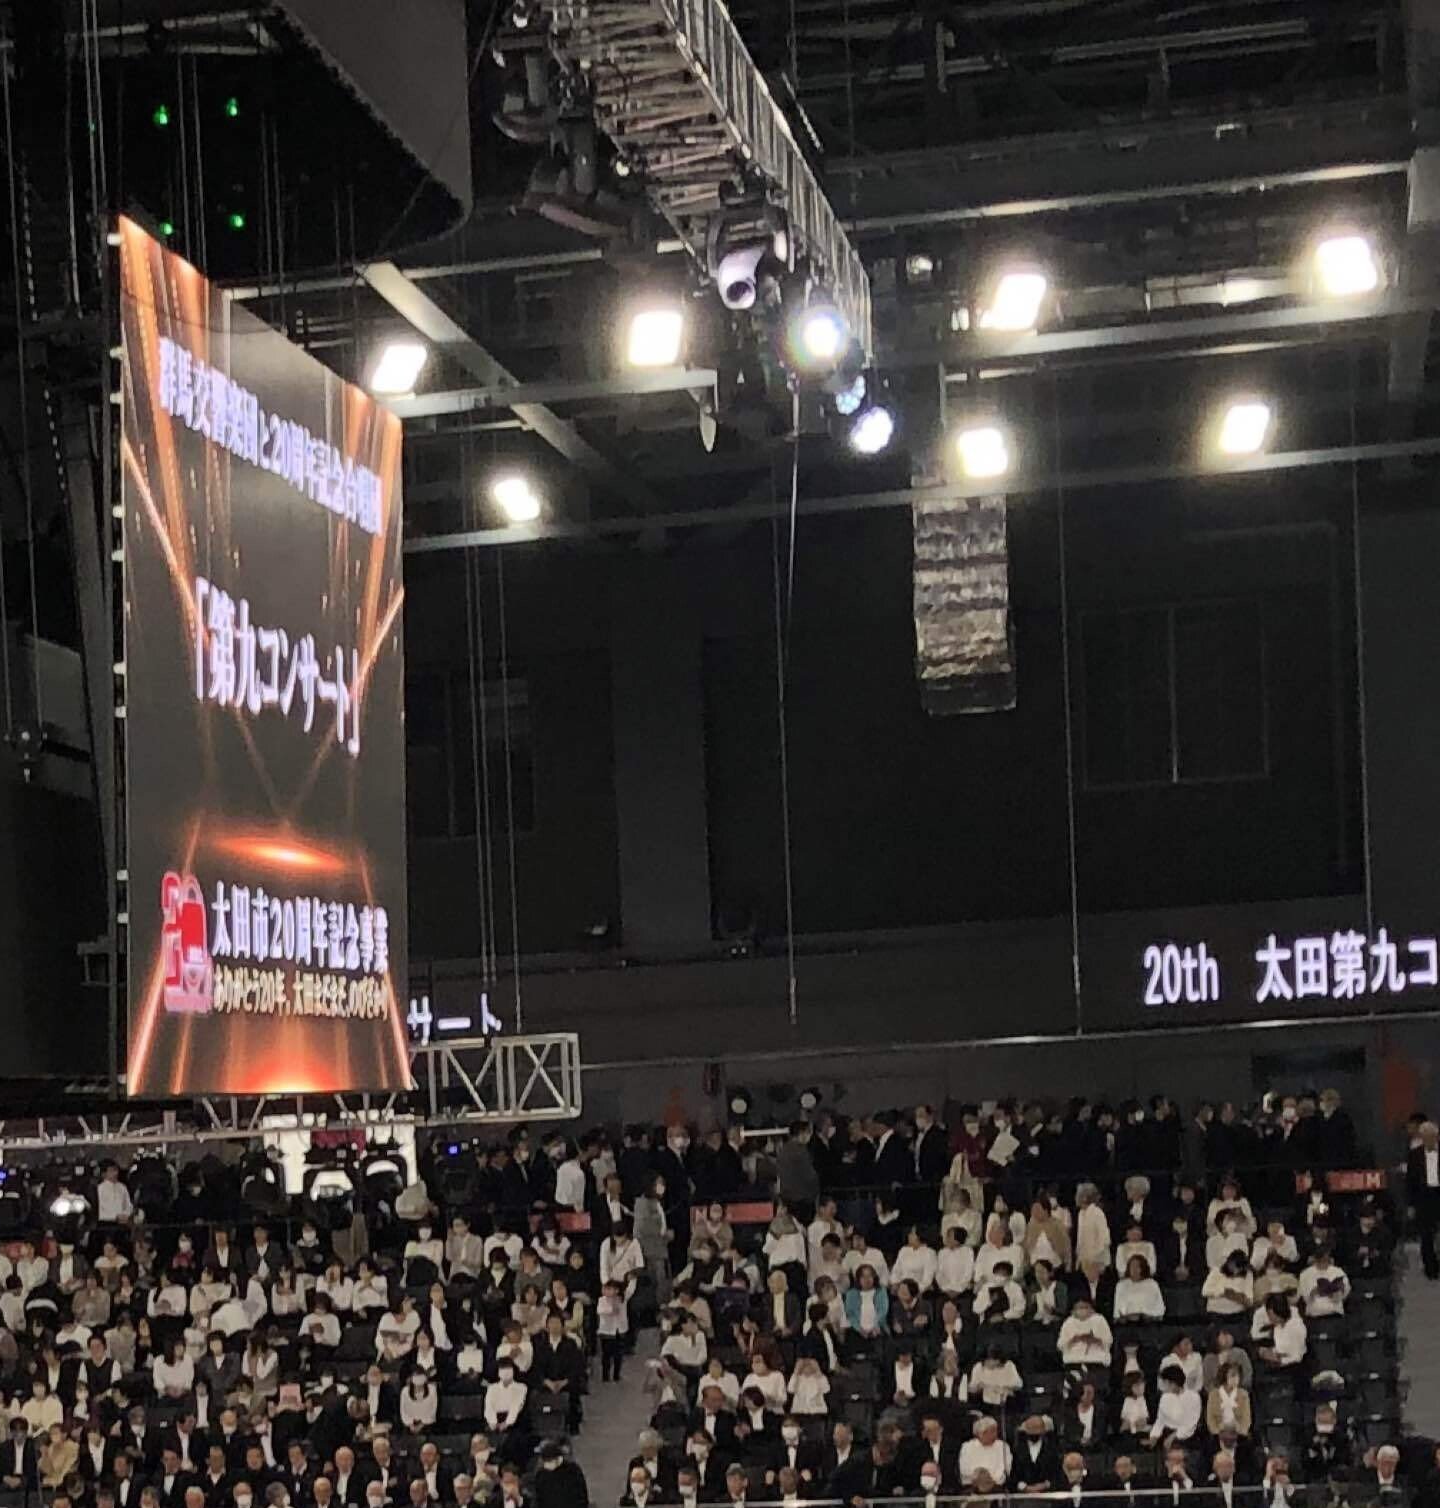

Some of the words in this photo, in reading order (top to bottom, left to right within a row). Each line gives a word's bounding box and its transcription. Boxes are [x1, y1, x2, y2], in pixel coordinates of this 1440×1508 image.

[196, 576, 359, 758] 「第九コンサート」
[1143, 942, 1219, 1005] 20th
